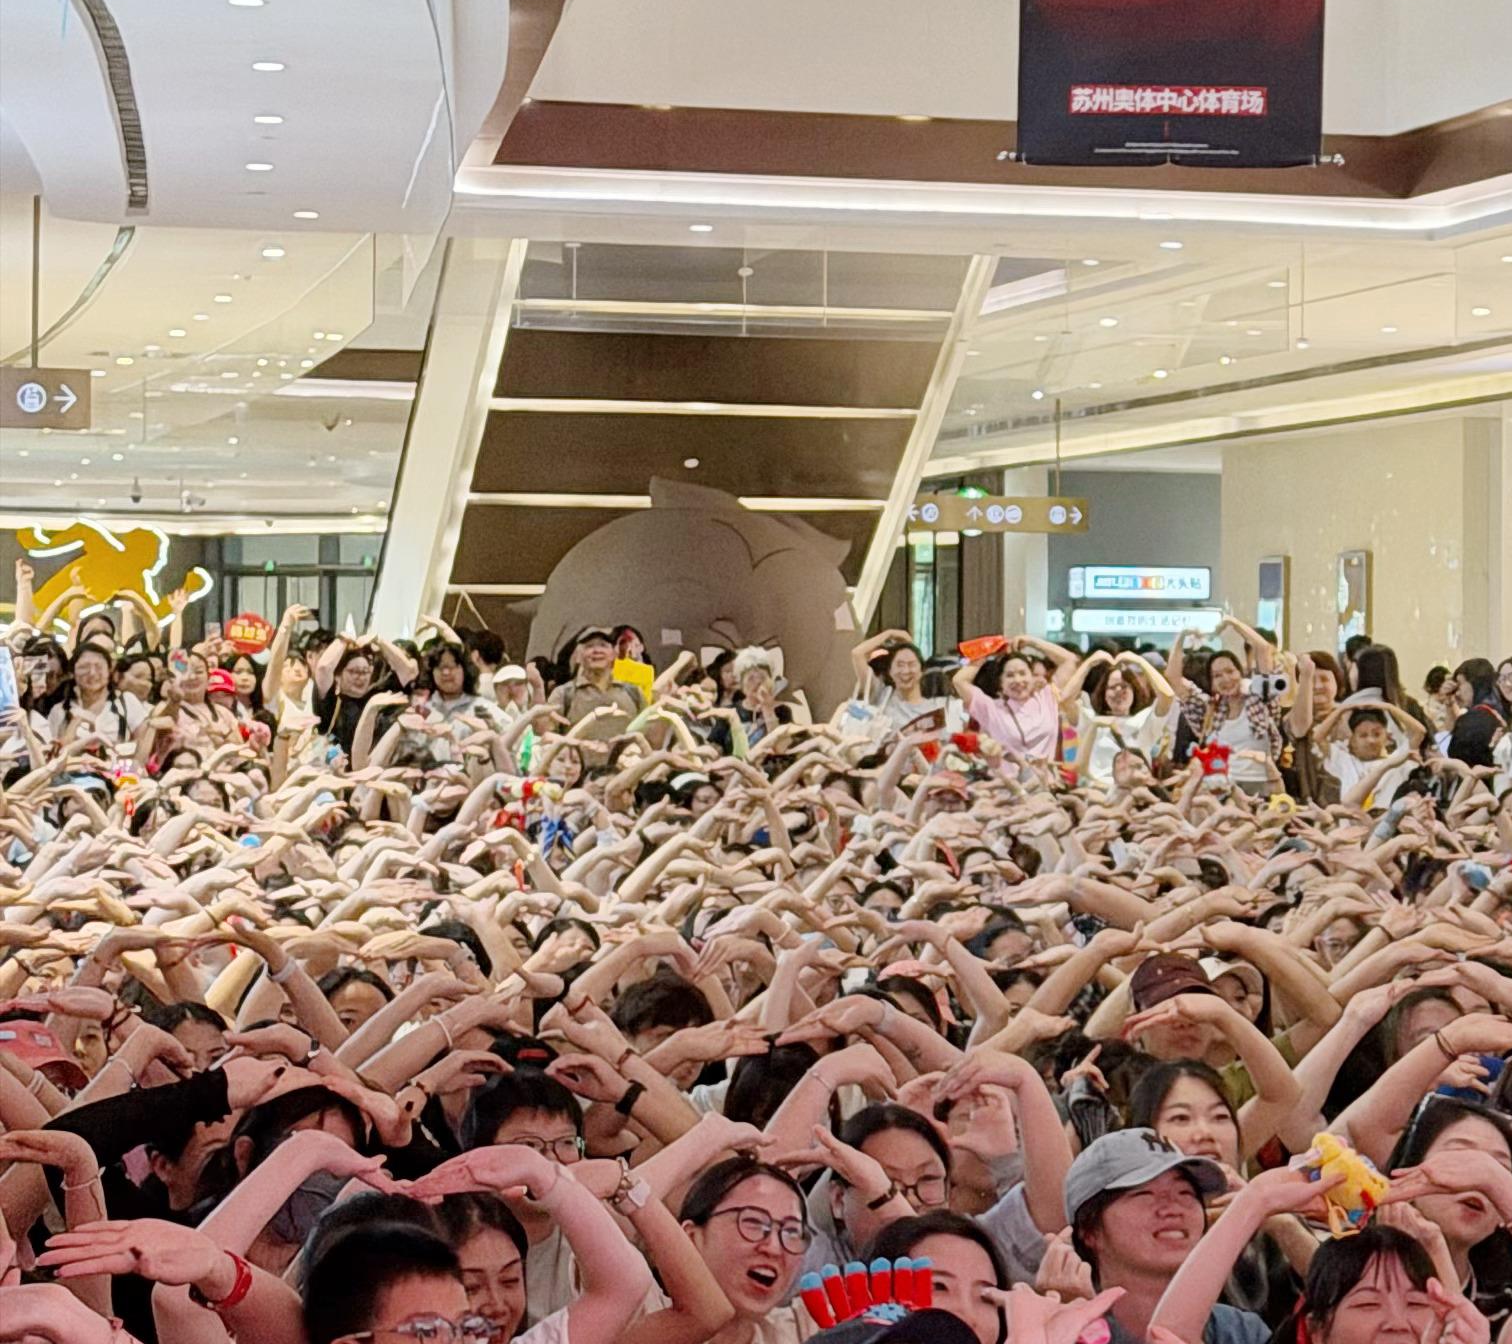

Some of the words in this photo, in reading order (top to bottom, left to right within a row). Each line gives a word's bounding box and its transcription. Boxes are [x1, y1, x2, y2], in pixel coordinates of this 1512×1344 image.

[1071, 87, 1264, 113] 苏州奥体中心体育场
